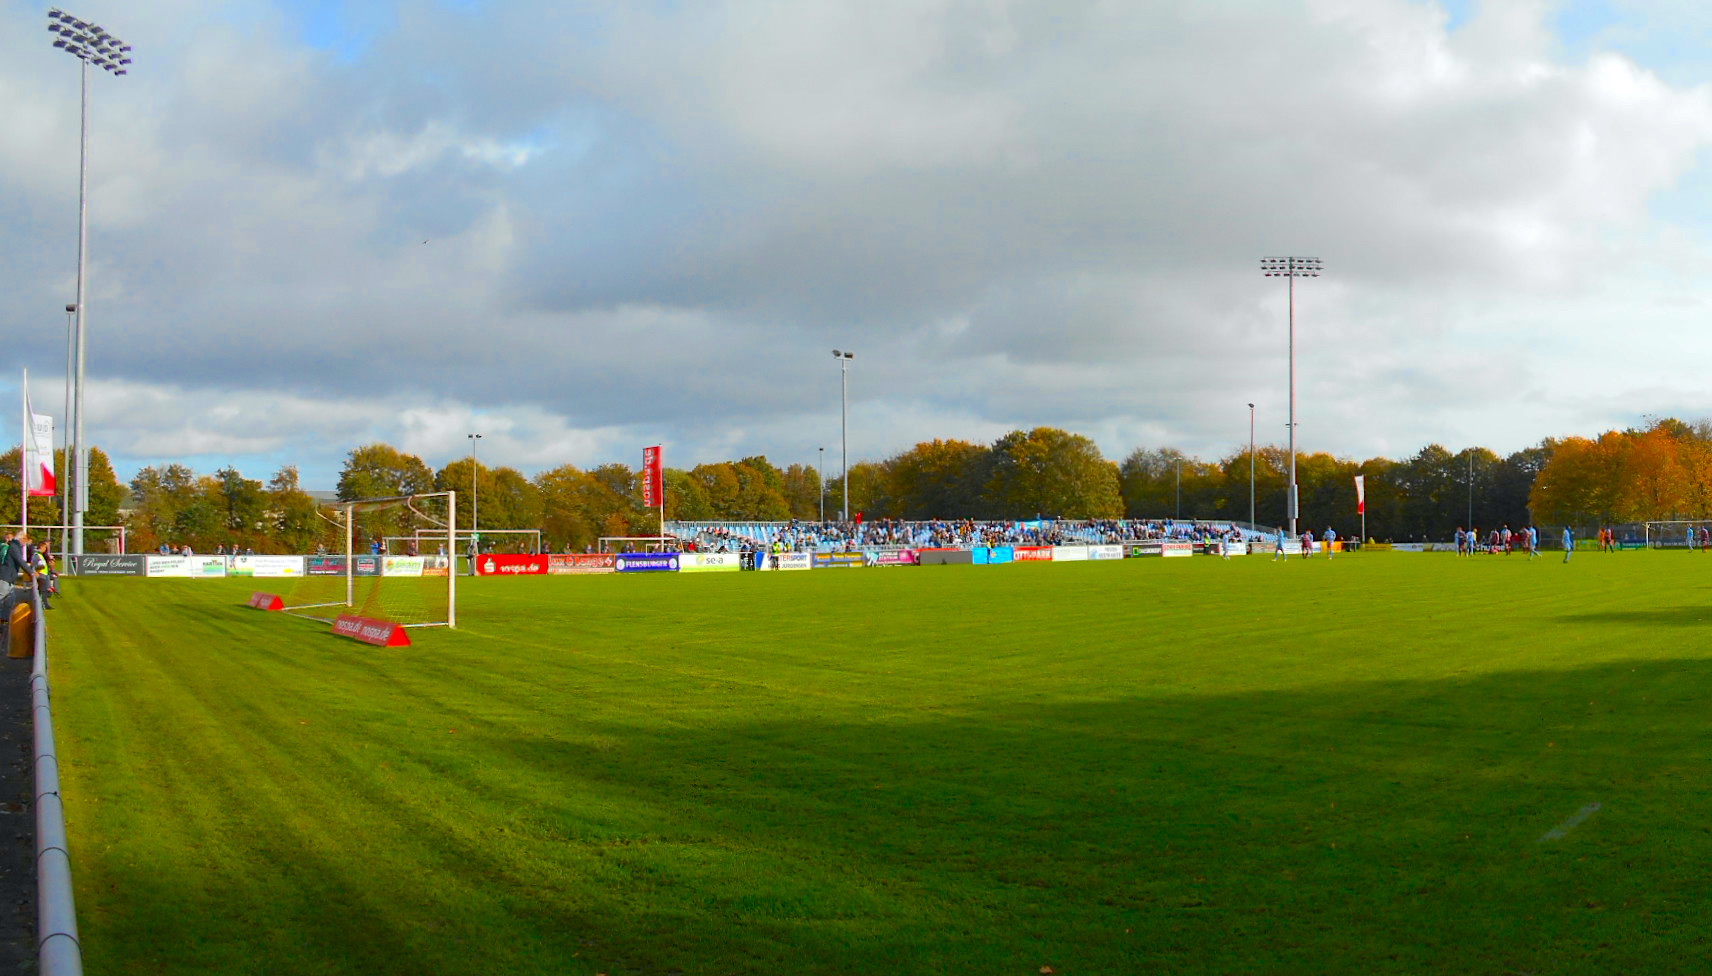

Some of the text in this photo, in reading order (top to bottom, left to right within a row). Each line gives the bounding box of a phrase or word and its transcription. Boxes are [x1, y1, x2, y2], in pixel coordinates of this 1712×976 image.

[83, 557, 109, 570] Royal
[110, 558, 138, 567] Service
[626, 560, 668, 568] FLENSBURGER
